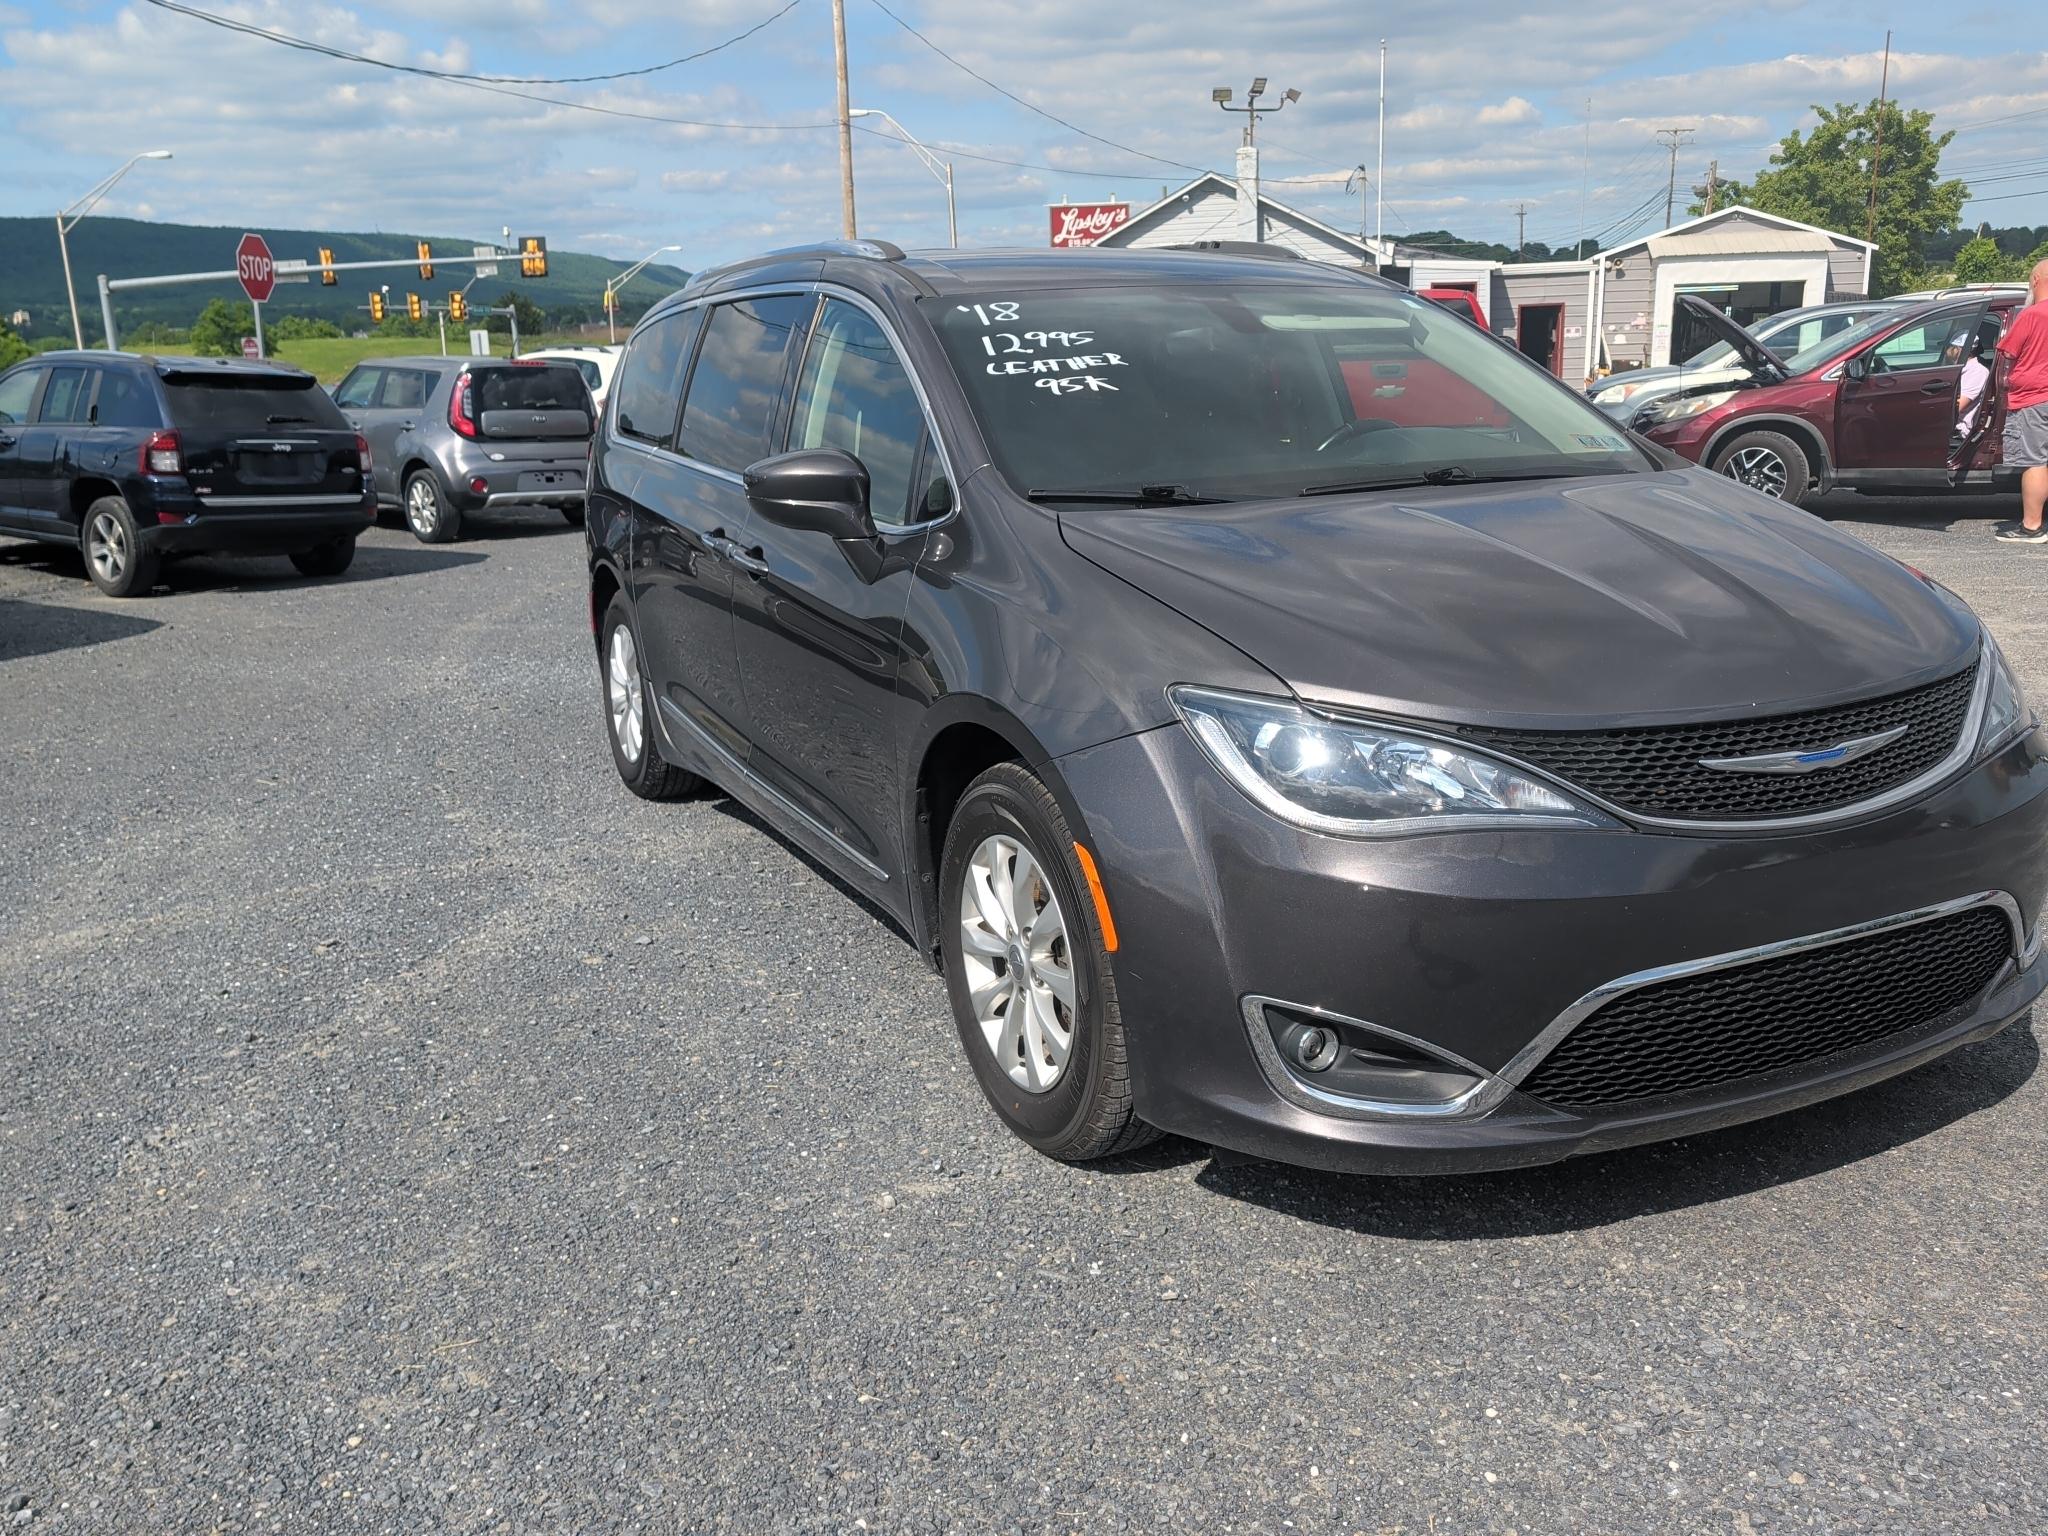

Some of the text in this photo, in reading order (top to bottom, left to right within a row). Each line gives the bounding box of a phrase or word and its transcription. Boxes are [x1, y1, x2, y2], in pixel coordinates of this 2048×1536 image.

[1053, 208, 1126, 243] Lipsky's
[241, 255, 270, 281] STOP
[982, 331, 1095, 356] 12995
[987, 353, 1128, 374] LEATHER
[1035, 375, 1119, 395] 95K
[273, 443, 291, 452] Jeep
